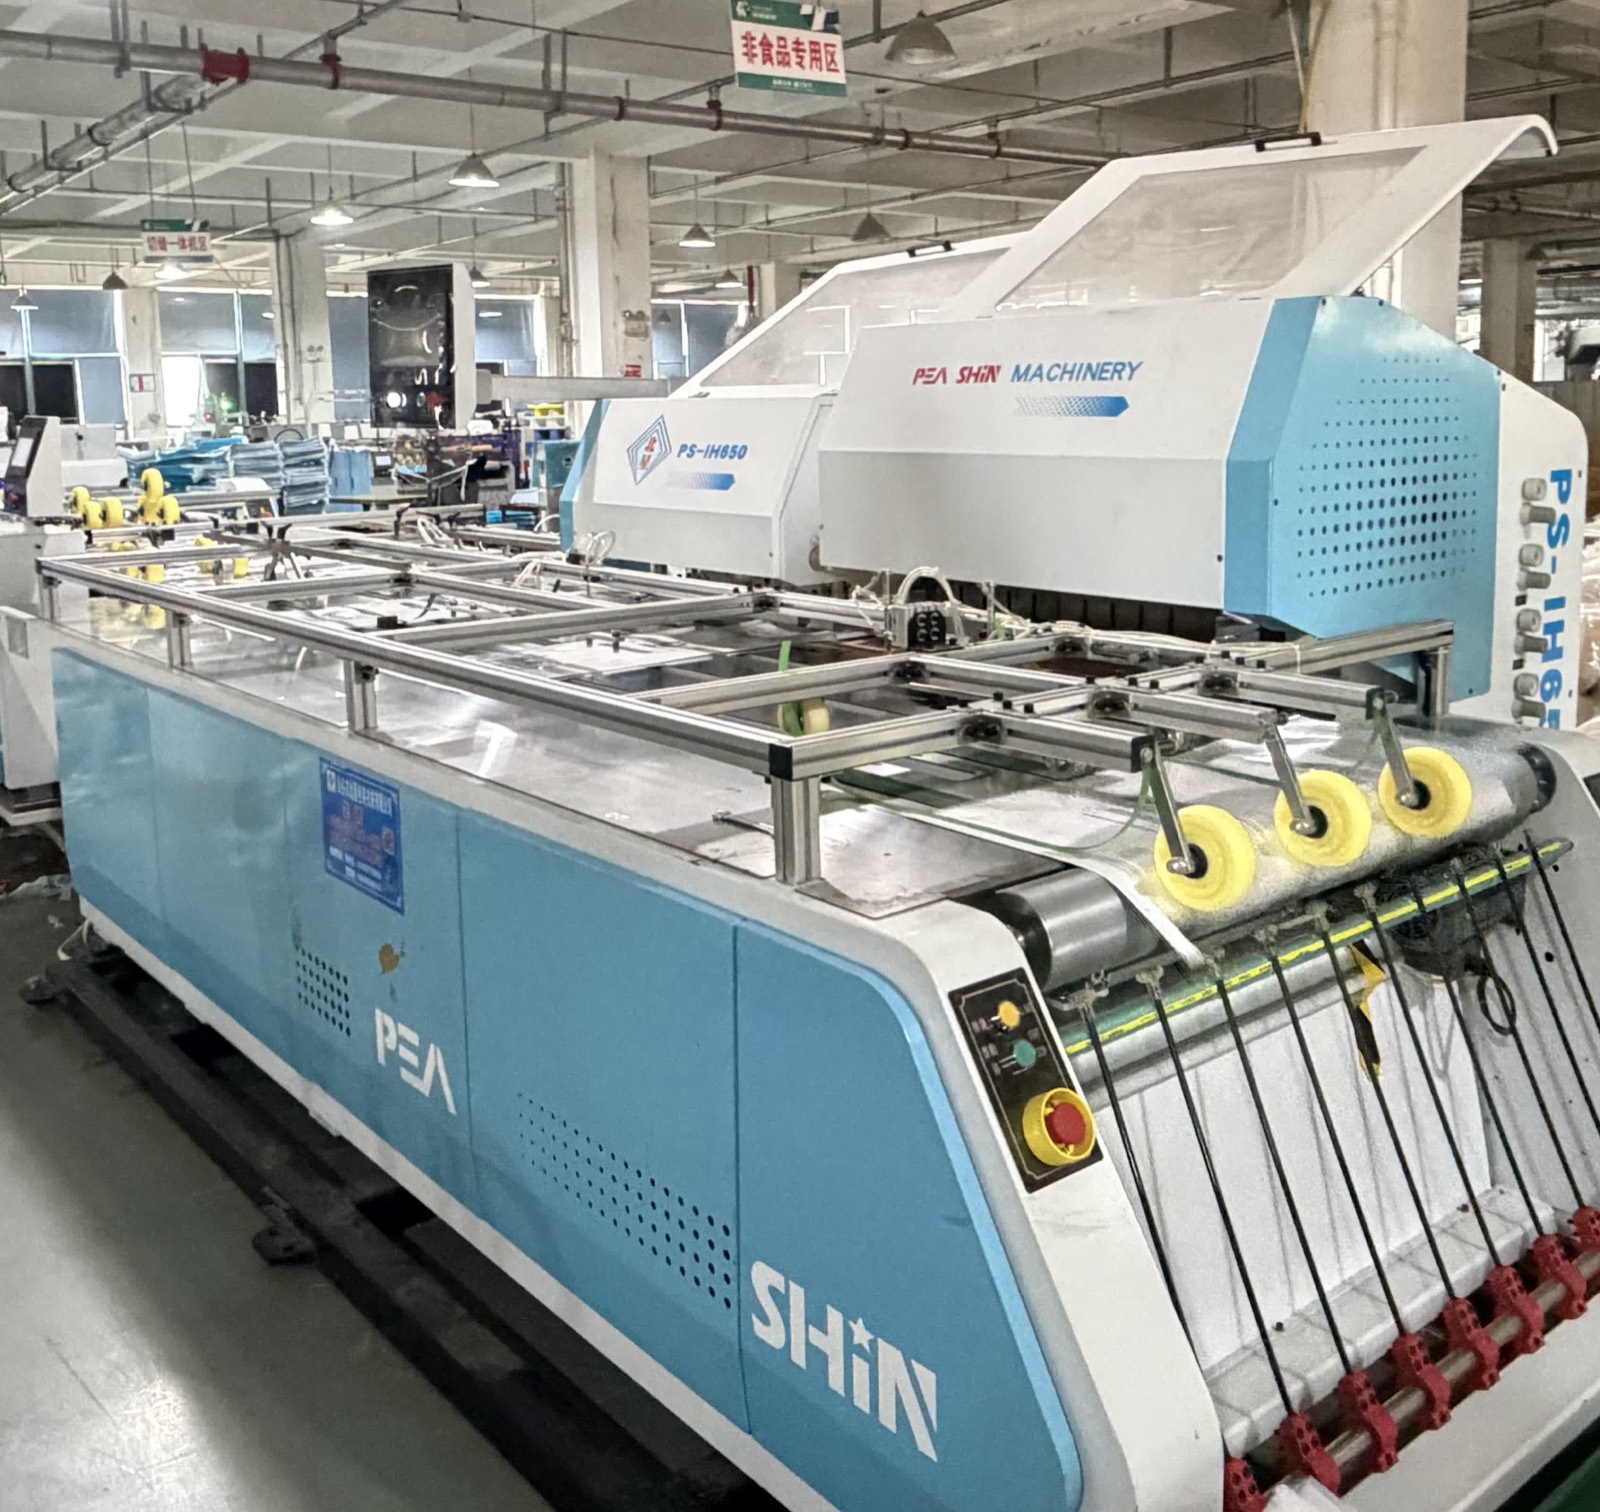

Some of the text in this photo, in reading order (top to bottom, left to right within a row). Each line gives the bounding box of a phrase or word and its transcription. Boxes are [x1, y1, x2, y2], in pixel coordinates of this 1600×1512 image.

[741, 31, 840, 74] 非食品专用区
[912, 367, 948, 386] PEA
[1010, 361, 1144, 383] MACHINERY
[677, 443, 748, 461] PS-IH650
[375, 1007, 457, 1116] PEA
